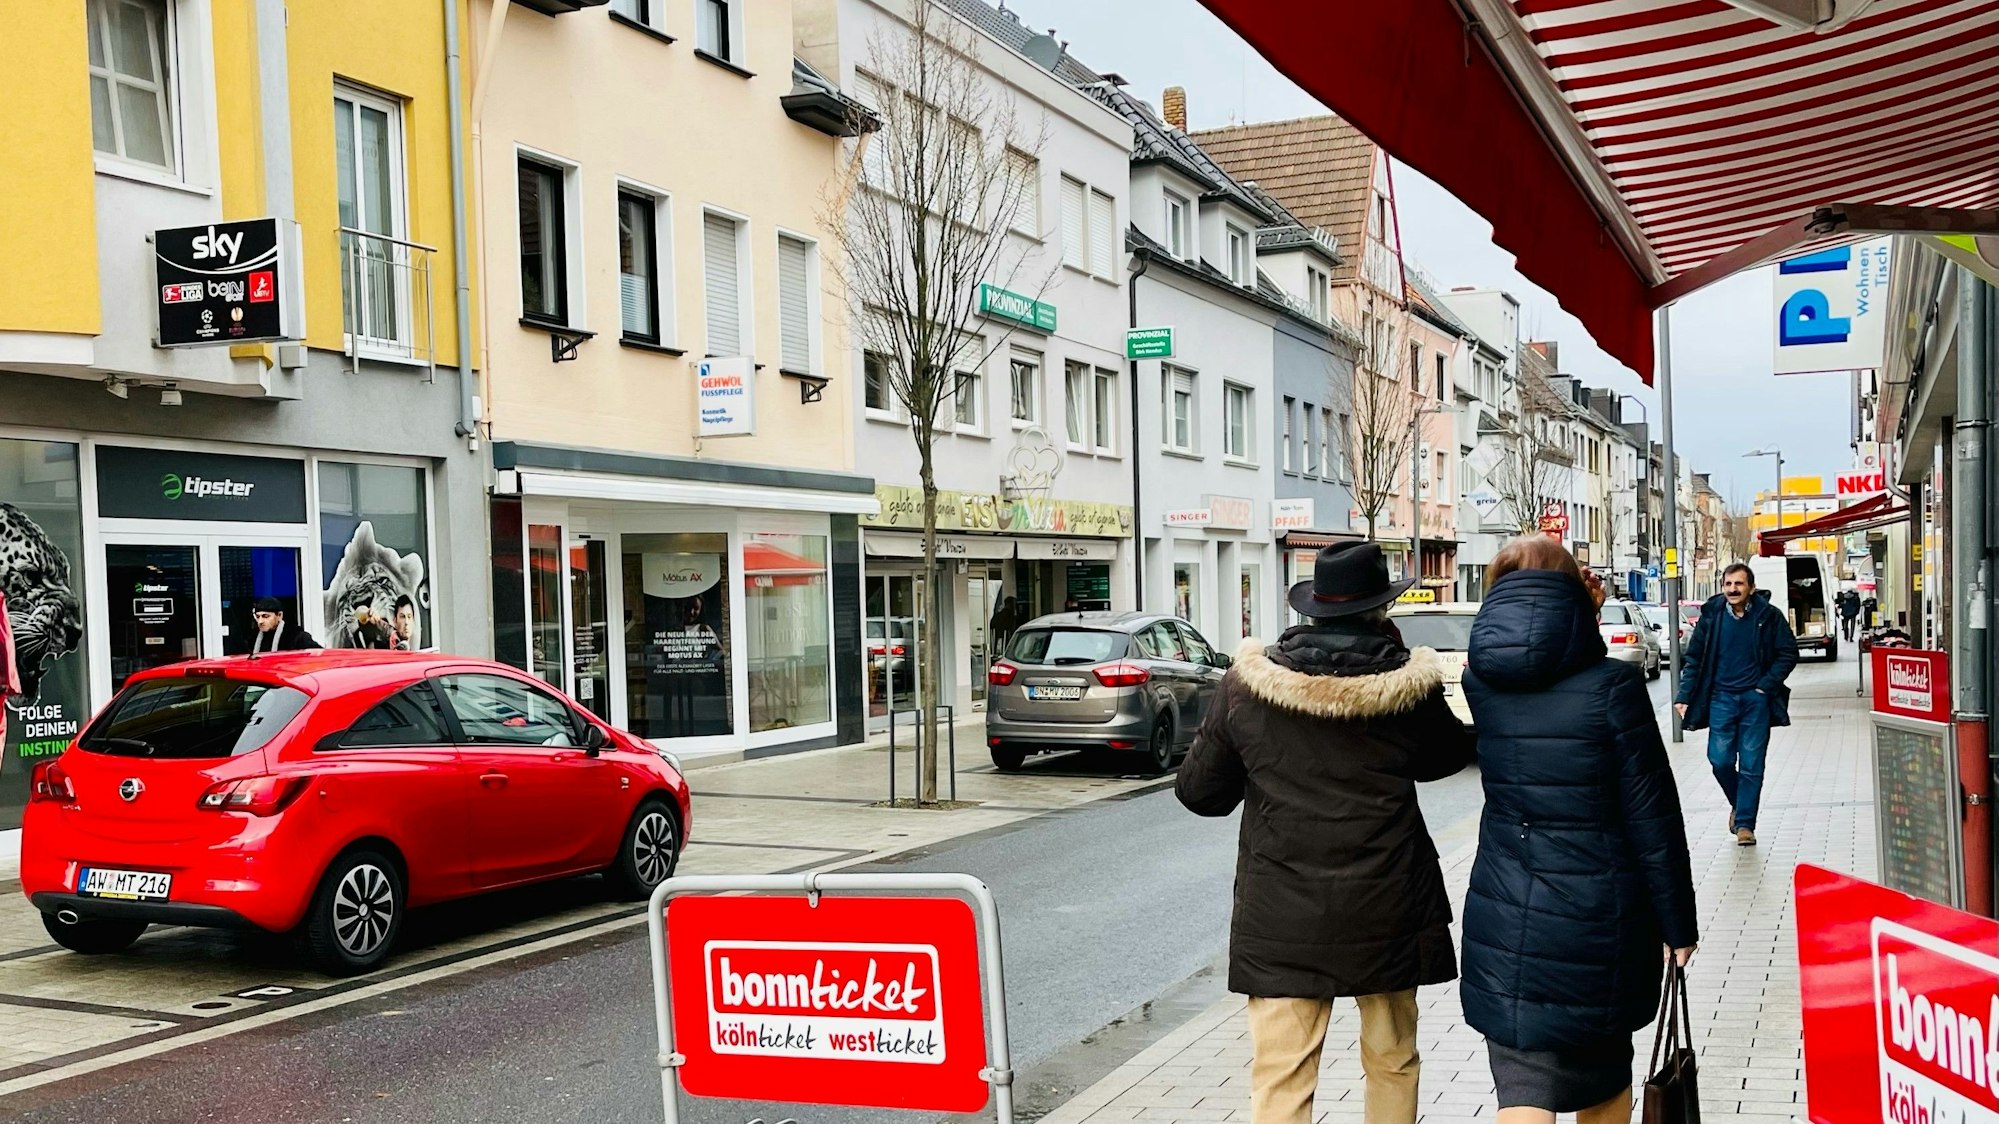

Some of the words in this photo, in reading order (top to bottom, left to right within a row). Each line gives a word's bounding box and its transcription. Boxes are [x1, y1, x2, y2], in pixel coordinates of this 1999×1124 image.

[192, 226, 243, 264] sky
[1875, 246, 1887, 287] Tisch
[1857, 247, 1869, 317] Wohnen
[182, 290, 202, 300] LIGA
[986, 288, 1034, 319] PROVINZIAL
[1128, 330, 1170, 339] PROVINZIAL
[701, 376, 743, 388] GEHWOL
[701, 388, 743, 397] FUSSPFLEGE
[184, 476, 254, 498] tipster
[960, 494, 994, 528] EIS
[1170, 513, 1208, 522] SINGER
[1275, 515, 1310, 527] PFAFF
[1649, 568, 1656, 576] P
[654, 631, 666, 639] DIE
[667, 631, 685, 639] NEUE
[663, 645, 693, 653] BEGINNT
[667, 652, 692, 660] MOTUS
[1890, 662, 1929, 690] kölnticket
[1034, 686, 1045, 696] BN
[18, 704, 63, 721] FOLGE
[25, 720, 78, 738] DEINEM
[87, 871, 108, 889] AW
[115, 873, 137, 892] MT
[138, 875, 167, 894] 216
[720, 956, 928, 1013] bonnticket
[716, 1020, 818, 1050] kölnticket
[829, 1027, 938, 1055] westticket
